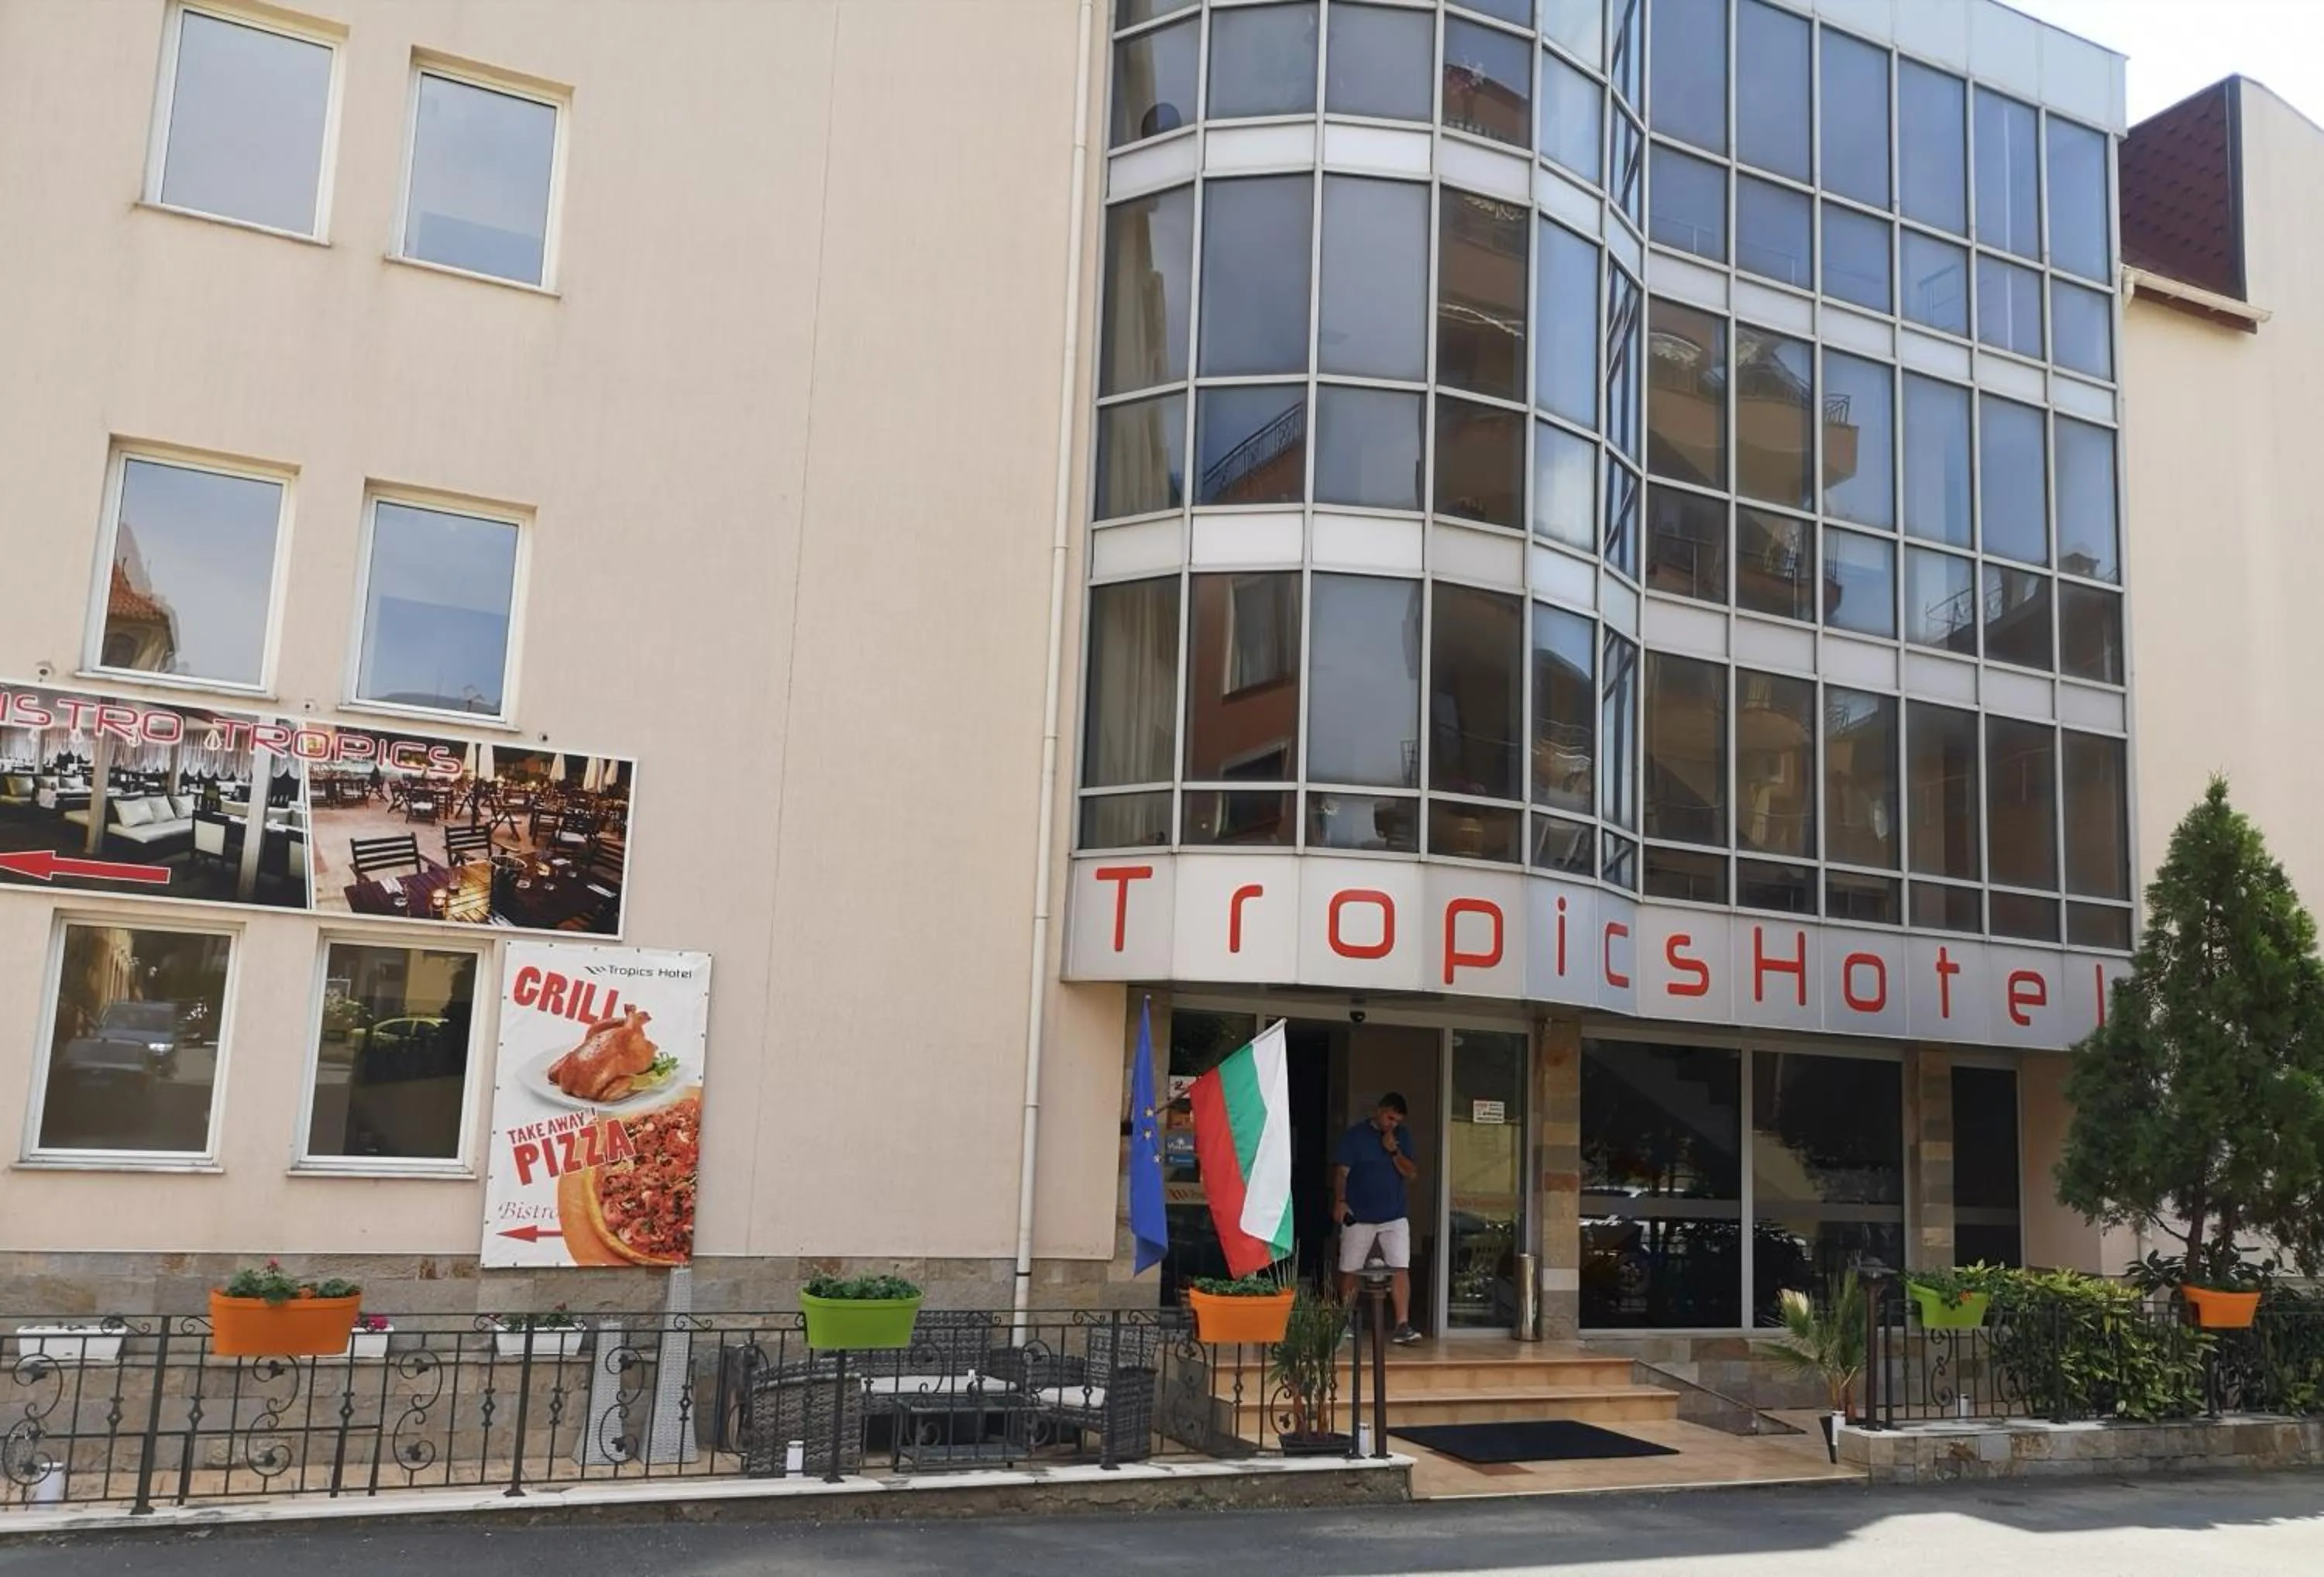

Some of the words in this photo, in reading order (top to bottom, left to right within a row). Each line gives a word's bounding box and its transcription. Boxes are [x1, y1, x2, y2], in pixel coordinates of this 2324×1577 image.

[213, 719, 463, 775] TROPICS
[514, 966, 620, 1025] GRILL
[608, 964, 654, 977] Tropics
[658, 968, 692, 979] Hotel
[507, 1122, 546, 1144] TAKE
[513, 1119, 635, 1186] PIZZA
